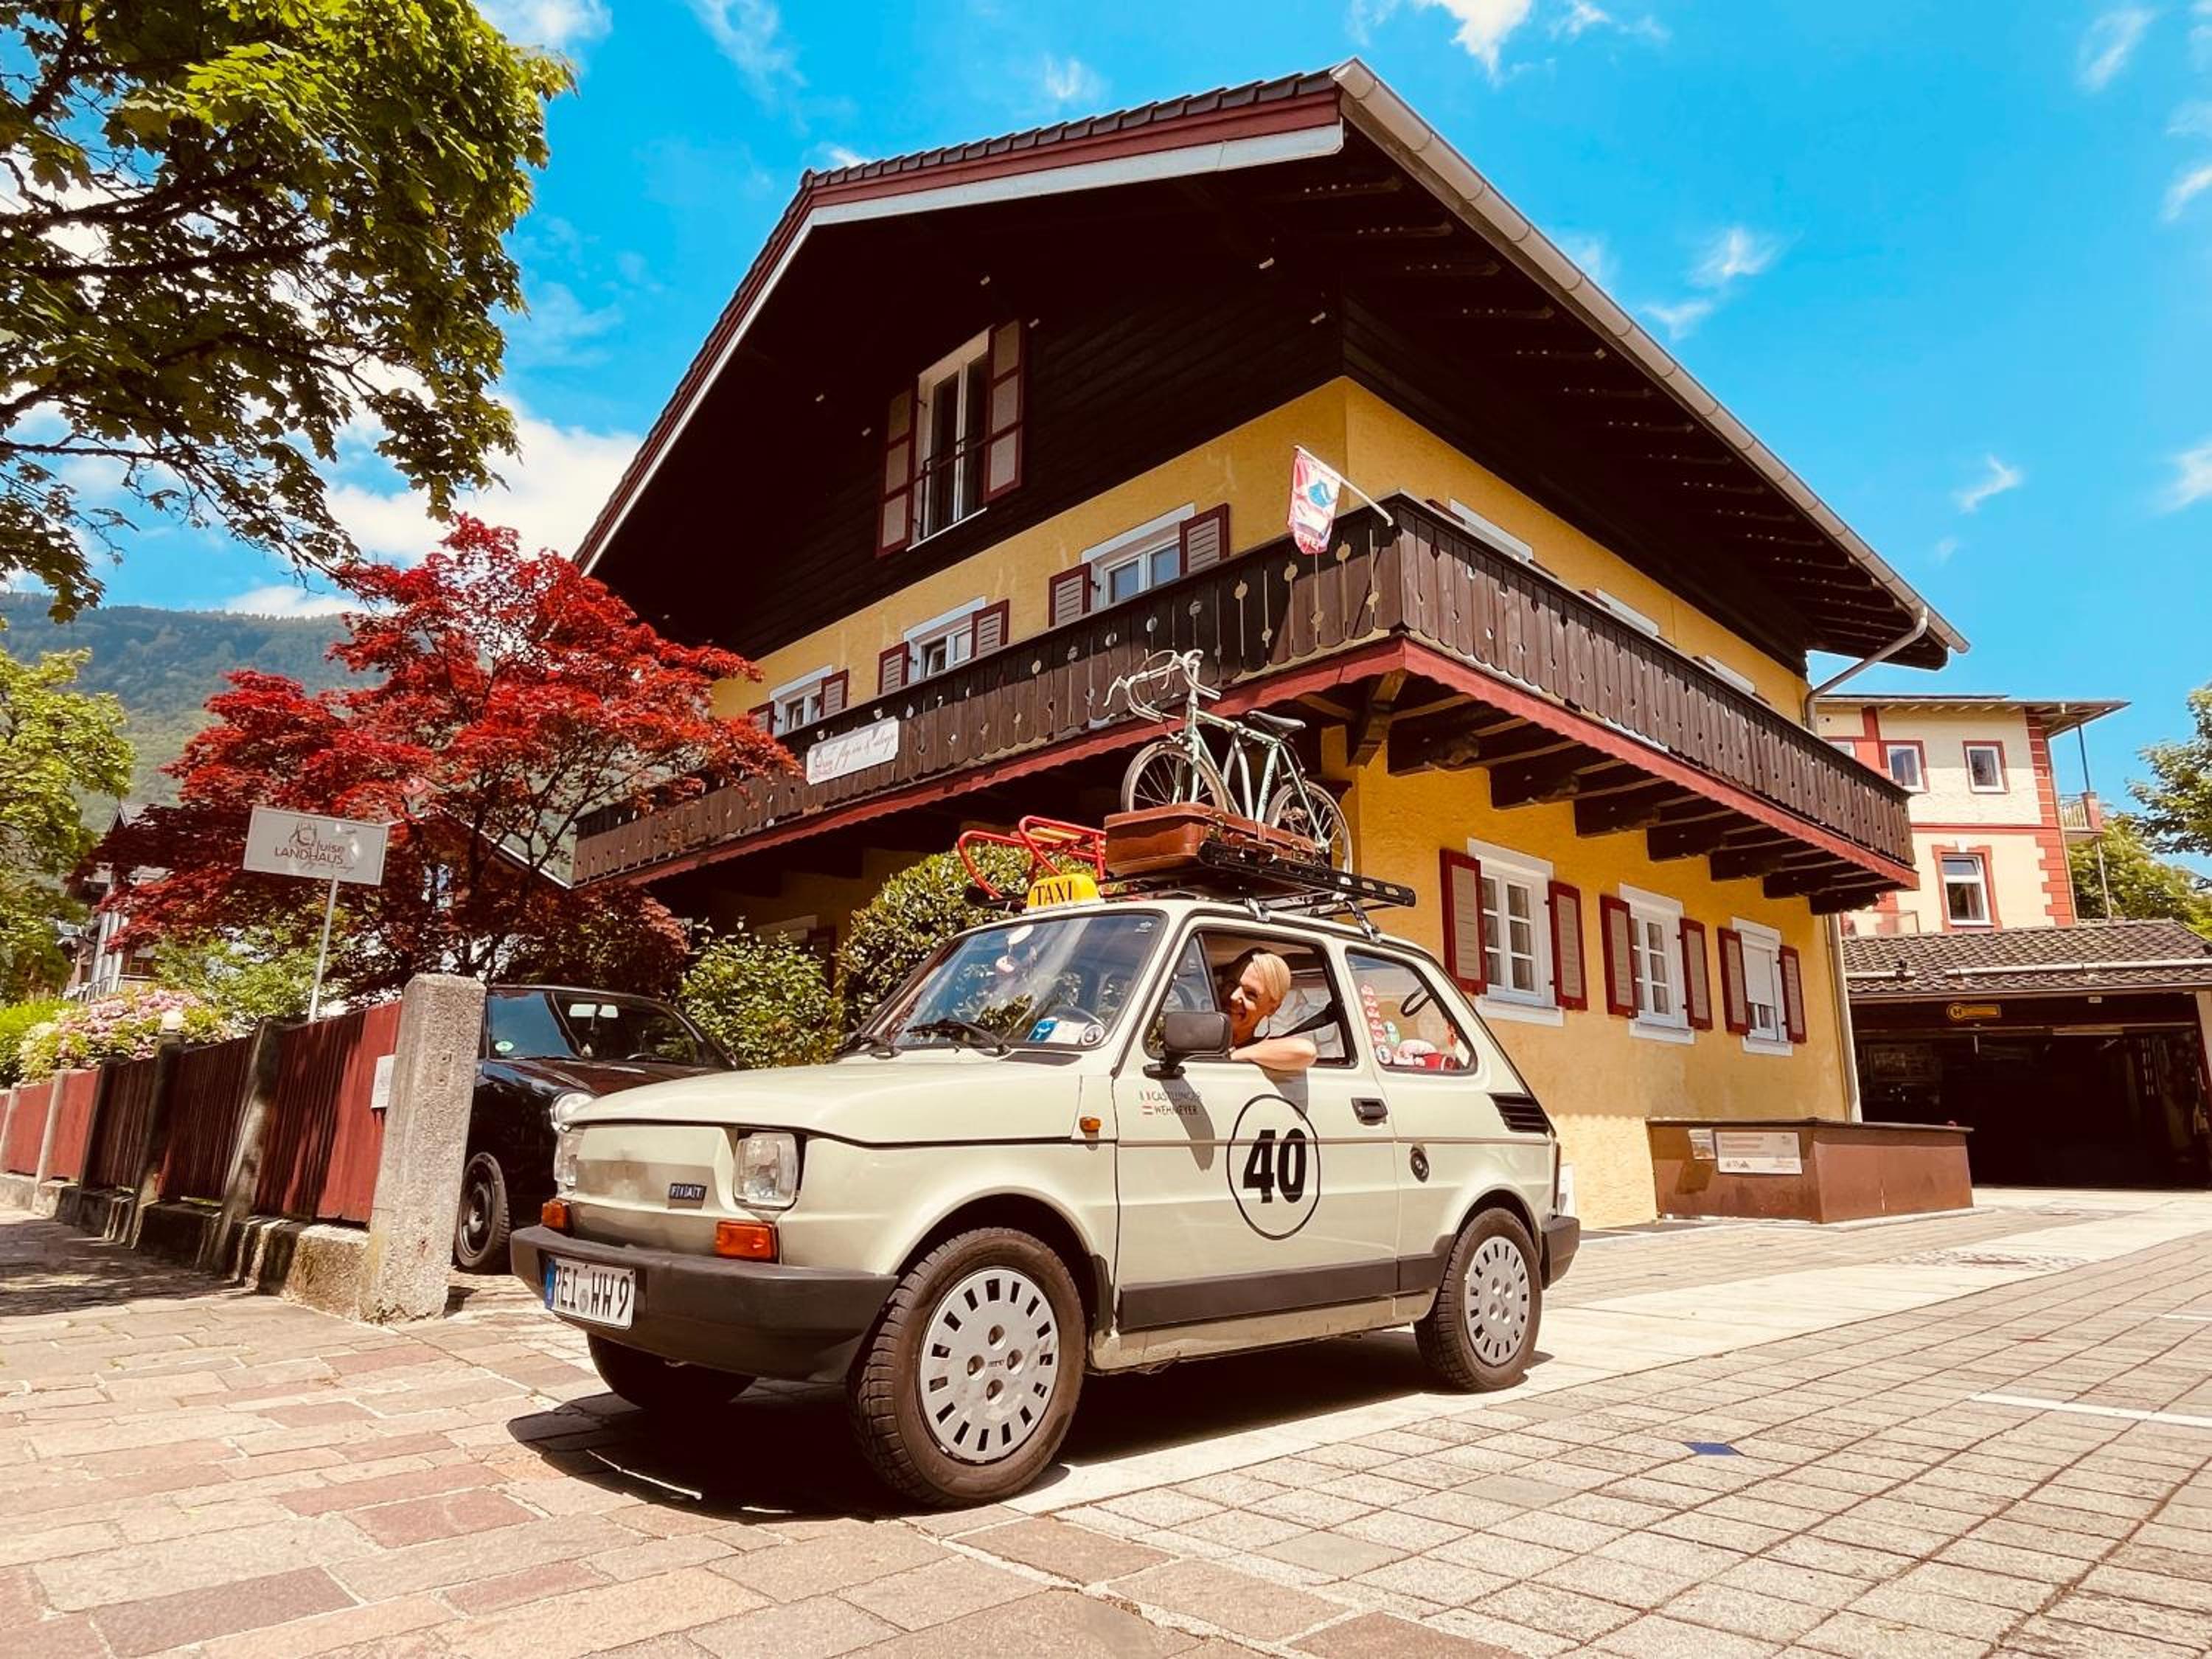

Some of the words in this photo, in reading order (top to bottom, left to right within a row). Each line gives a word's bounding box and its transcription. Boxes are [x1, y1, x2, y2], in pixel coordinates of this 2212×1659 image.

[274, 845, 344, 865] LANDHAUS
[1034, 880, 1072, 905] TAXI
[1243, 1128, 1307, 1203] 40
[671, 1185, 703, 1199] FIAT
